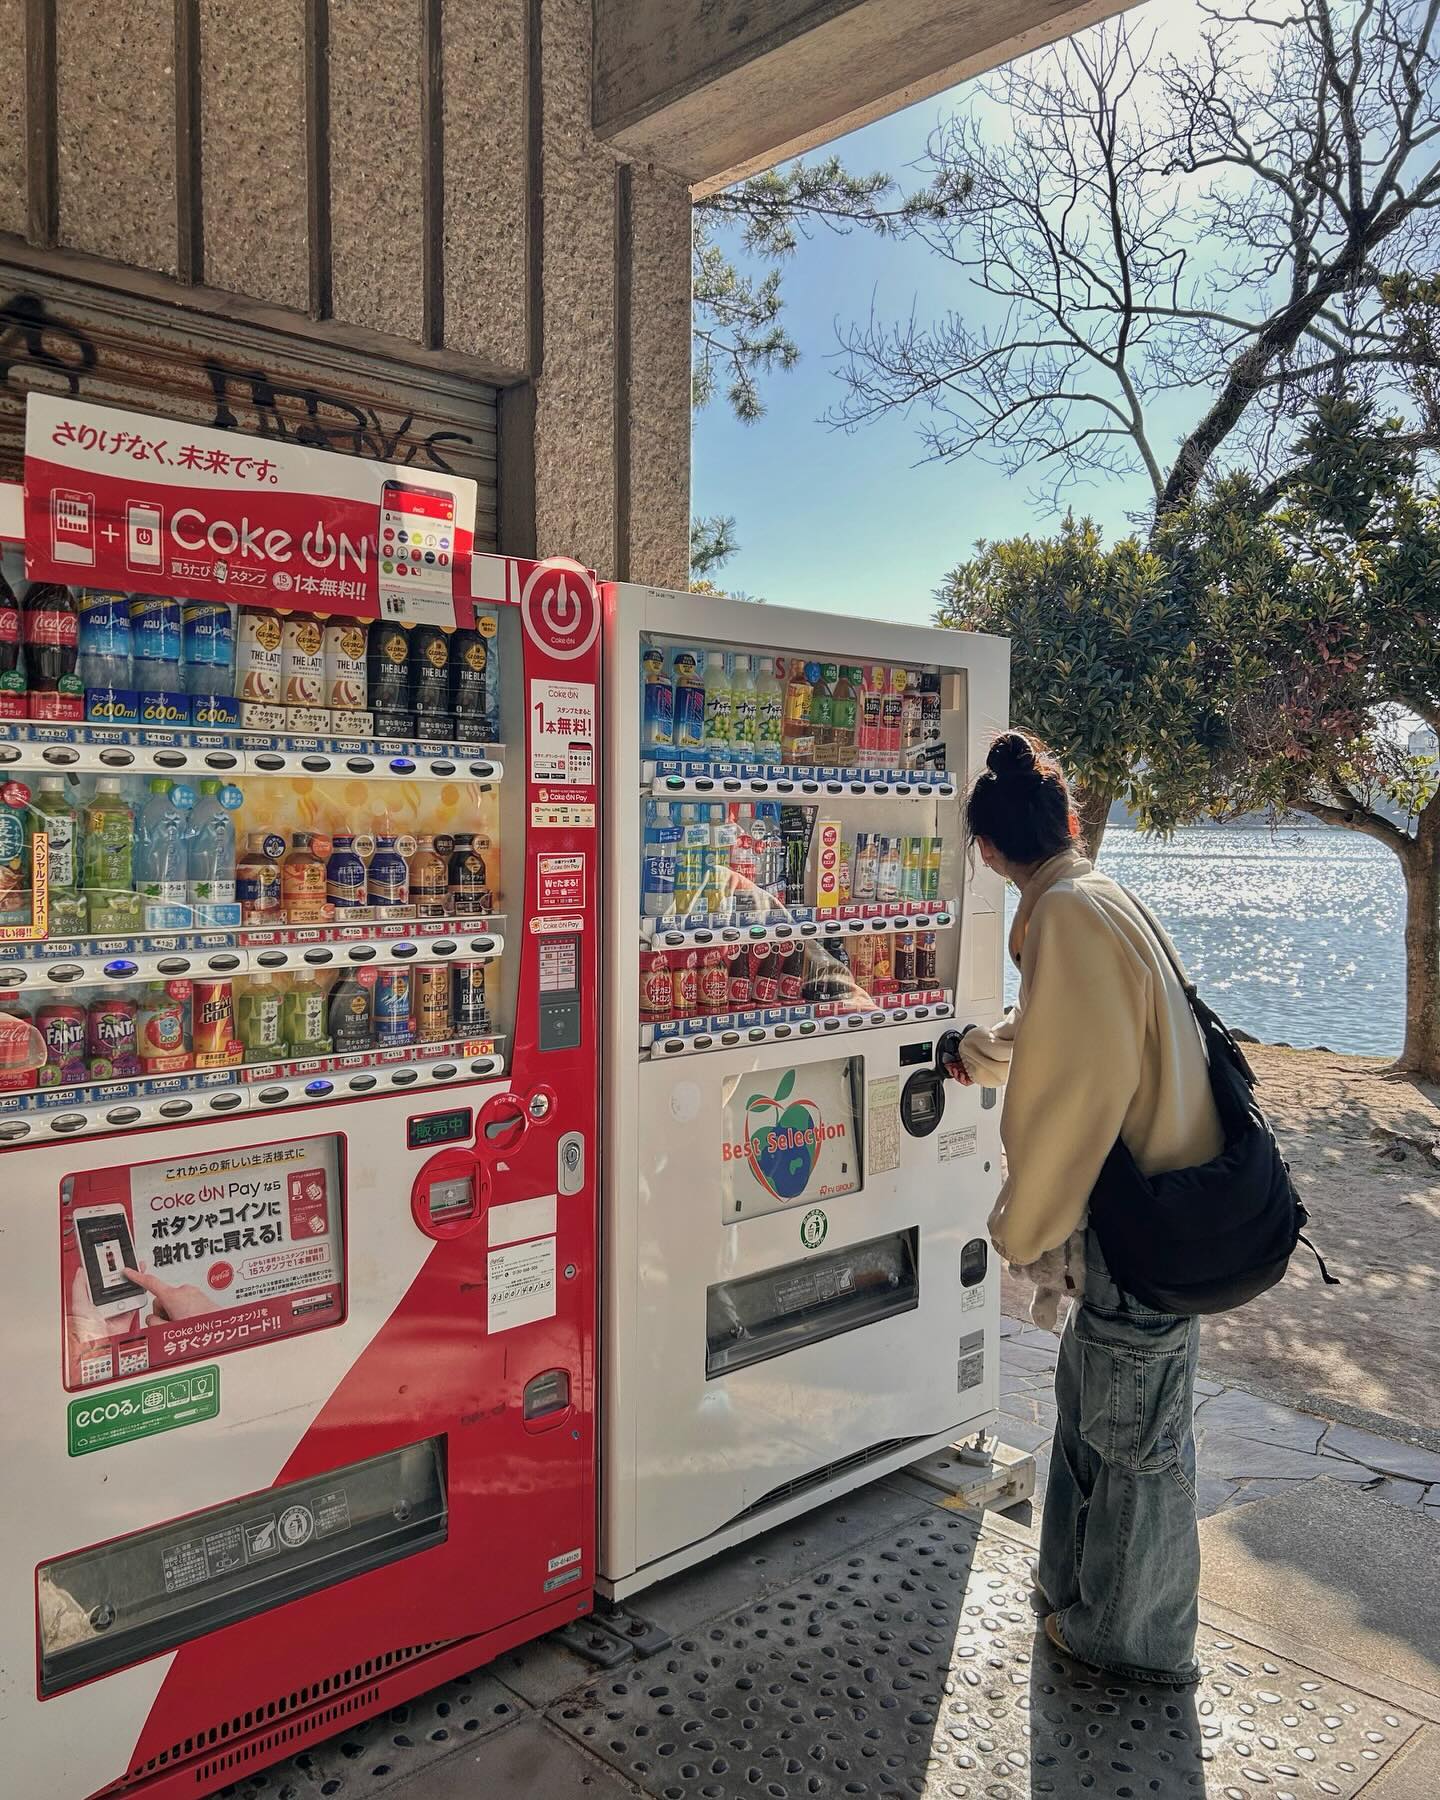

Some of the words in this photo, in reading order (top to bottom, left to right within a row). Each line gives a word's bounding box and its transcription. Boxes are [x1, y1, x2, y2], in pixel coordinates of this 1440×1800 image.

[52, 421, 278, 484] さりげなく、未来です。
[170, 508, 292, 562] Coke
[303, 521, 368, 574] ON
[171, 561, 211, 577] 買うたび
[230, 569, 268, 584] スタンプ
[277, 574, 288, 584] 15
[251, 650, 264, 660] THE
[292, 656, 305, 666] THE
[337, 660, 350, 670] THE
[381, 664, 393, 673] THE
[422, 667, 434, 677] THE
[460, 670, 472, 680] THE
[548, 689, 566, 699] Coke
[567, 690, 578, 699] ON
[91, 703, 137, 718] 600ml
[143, 704, 188, 721] 600ml
[196, 708, 237, 724] 600ml
[557, 706, 591, 715] スタンプたまると
[534, 702, 592, 737] 1本無料!
[576, 794, 587, 802] Pay
[35, 834, 46, 925] スペシャルプライス!!
[545, 879, 579, 888] Wでたまる!
[160, 1035, 178, 1043] Qoo
[103, 1085, 128, 1093] ¥140
[416, 1118, 463, 1138] 販売中
[722, 1138, 760, 1162] Best
[768, 1122, 846, 1153] Selection
[166, 1148, 304, 1180] これからの新しい生活様式に
[150, 1193, 195, 1211] Coke
[198, 1185, 224, 1202] ON
[228, 1182, 261, 1200] Pay
[264, 1181, 281, 1192] なら
[152, 1201, 281, 1239] ボタンやコインに
[153, 1222, 283, 1267] 触れずに買える!
[164, 1316, 281, 1356] 今すぐダウンロード!!
